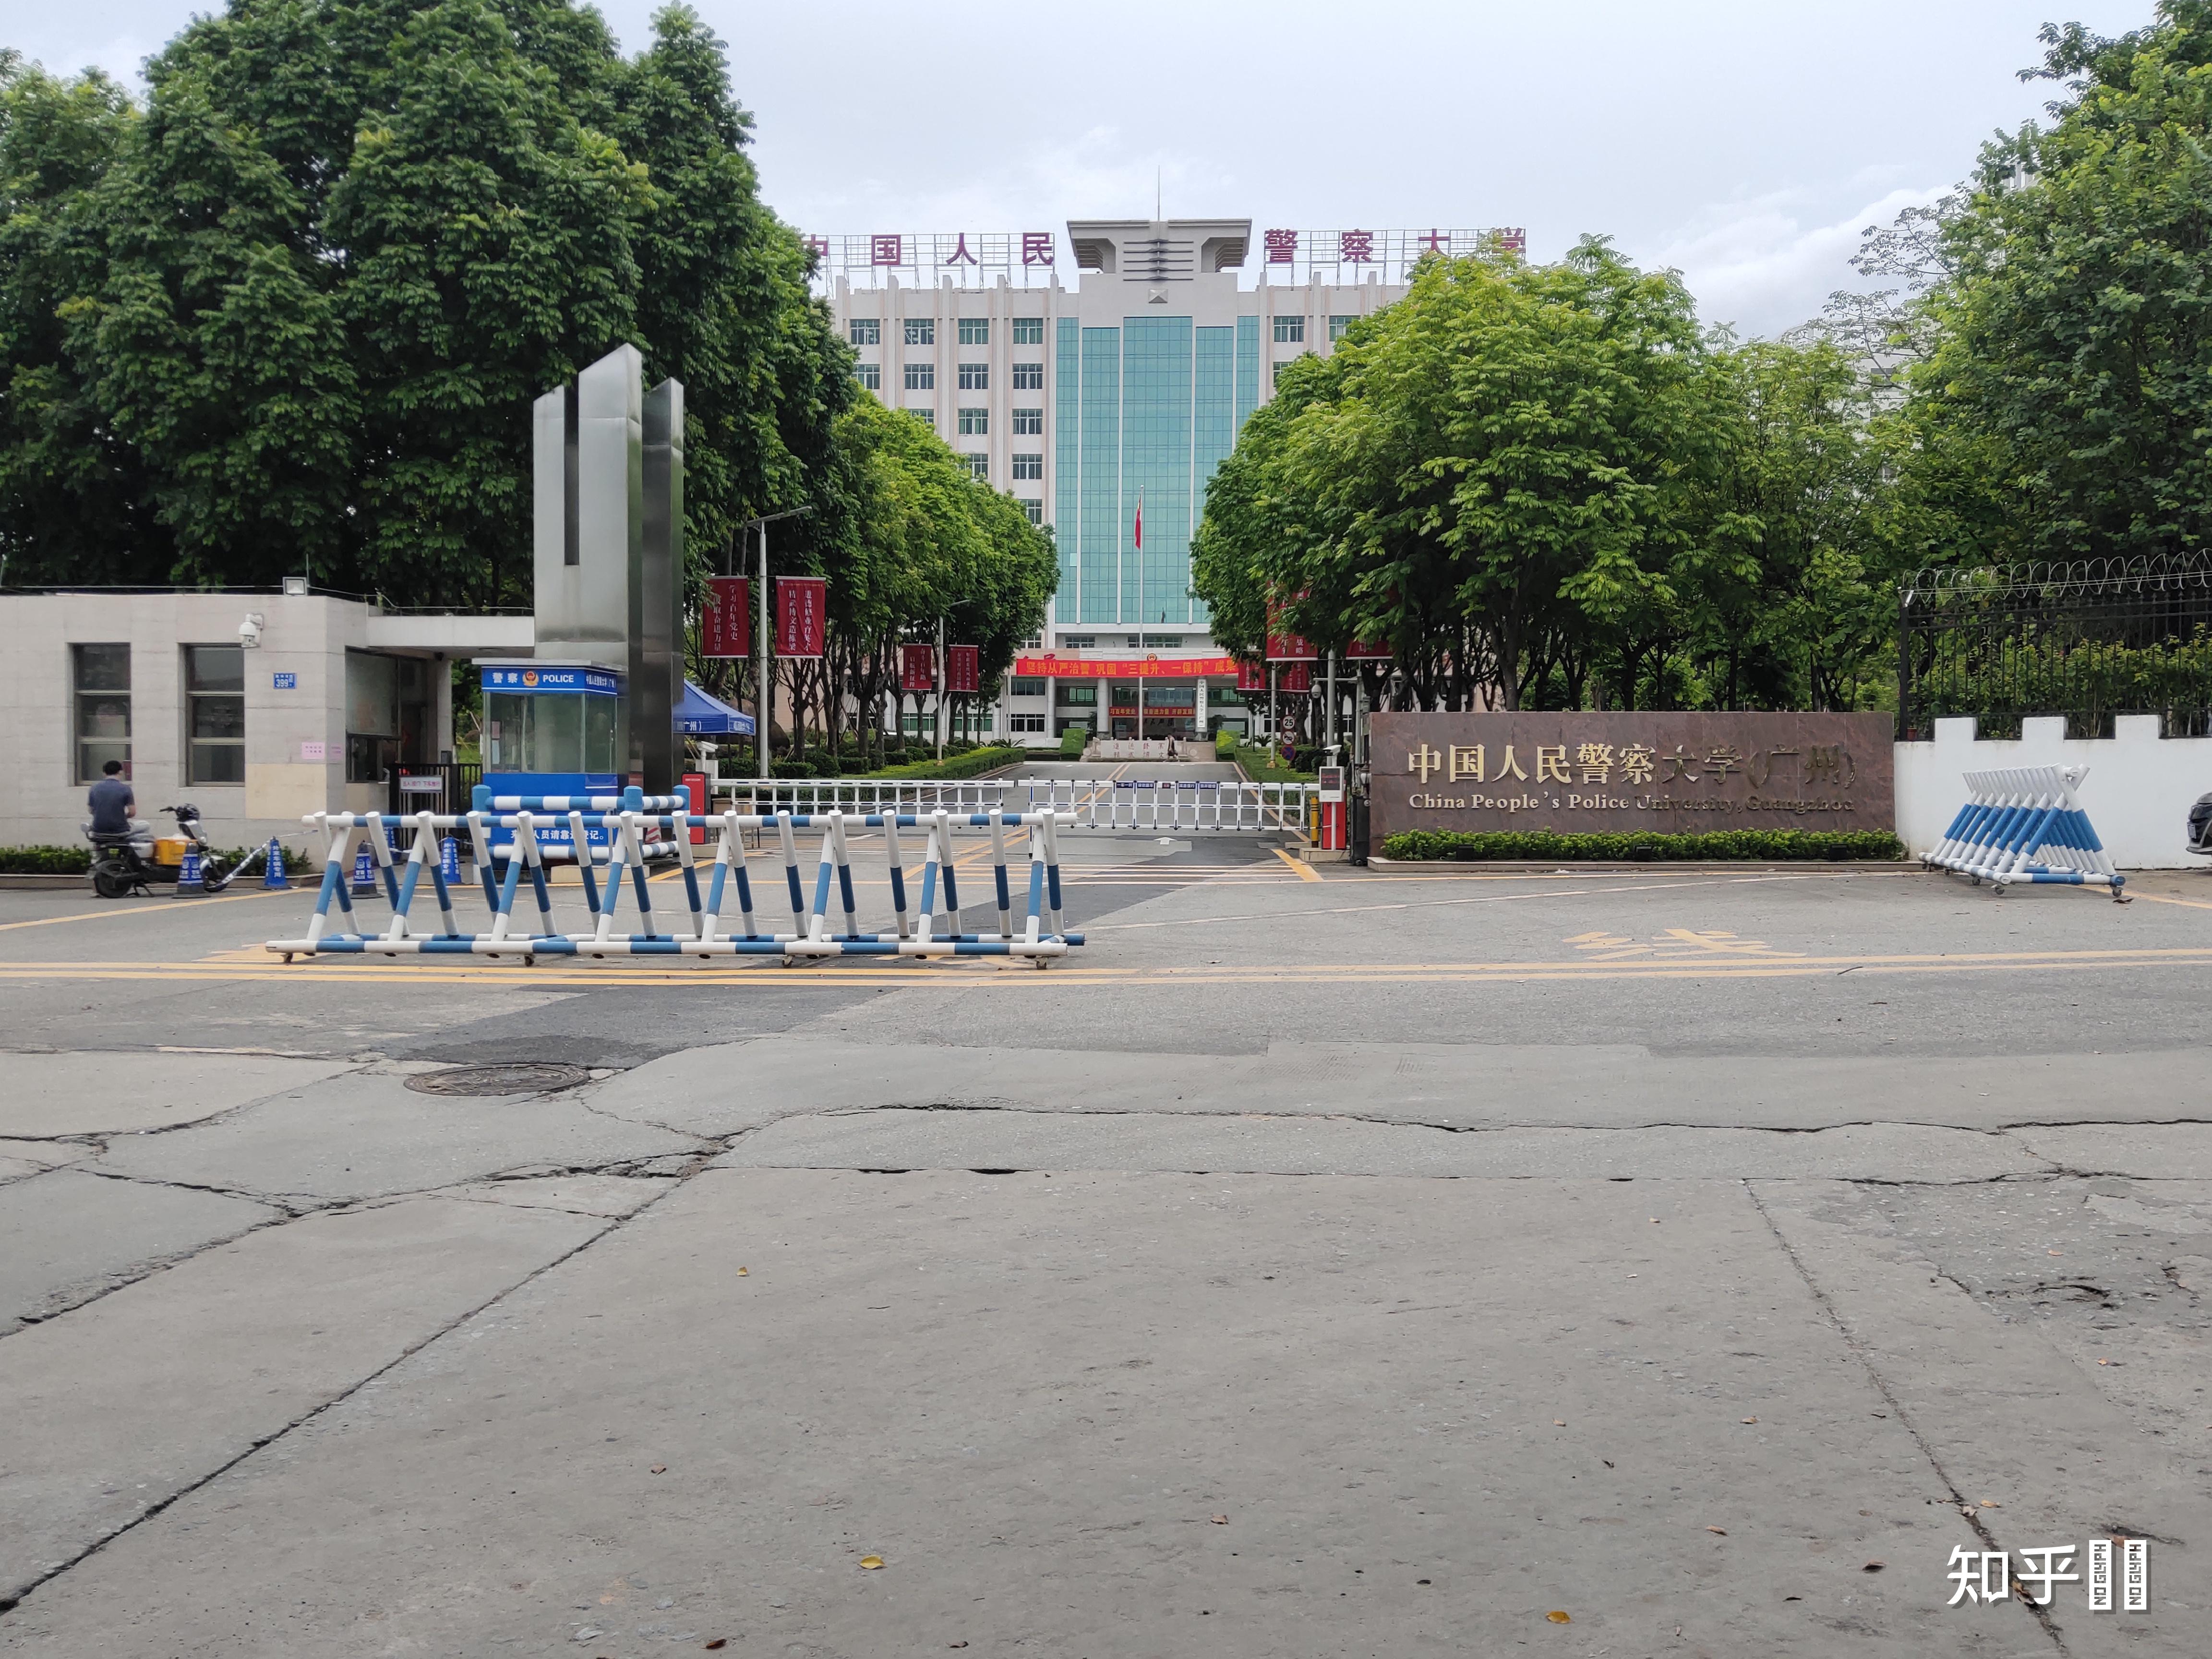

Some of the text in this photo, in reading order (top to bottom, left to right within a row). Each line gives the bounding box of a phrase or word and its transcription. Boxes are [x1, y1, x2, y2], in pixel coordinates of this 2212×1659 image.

[1096, 663, 1117, 675] 巩固
[276, 678, 289, 687] 399
[492, 672, 575, 684] 警察 POLICE
[1408, 743, 1857, 789] 中国人民警察大学（广州）
[1409, 793, 1466, 810] China
[1568, 793, 1630, 810] Police
[1746, 794, 1855, 815] Guangzhou
